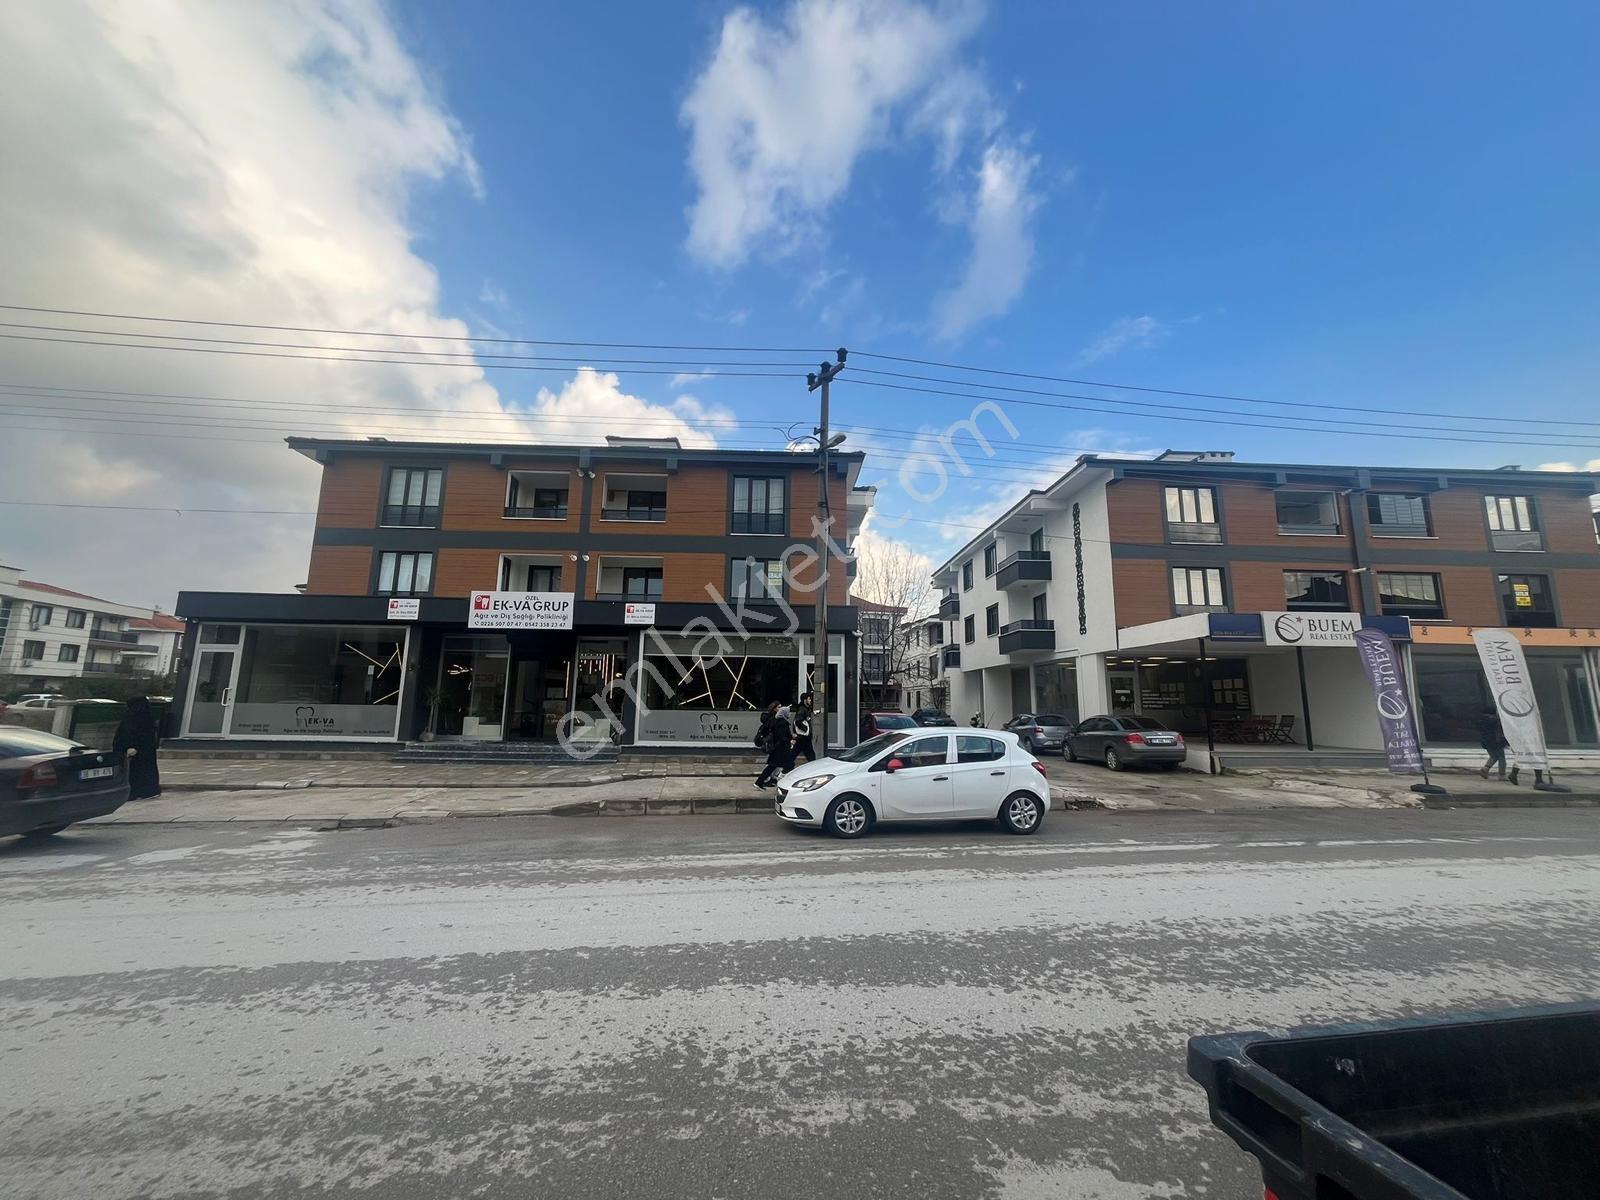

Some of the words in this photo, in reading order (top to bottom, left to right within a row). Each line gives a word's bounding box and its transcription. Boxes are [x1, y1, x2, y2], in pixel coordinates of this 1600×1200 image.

[493, 600, 531, 611] EK-VA
[533, 600, 569, 612] GRUP
[500, 612, 511, 620] Diş
[1308, 619, 1355, 632] BUEM
[308, 717, 335, 725] EK-VA
[713, 723, 739, 731] EK-VA
